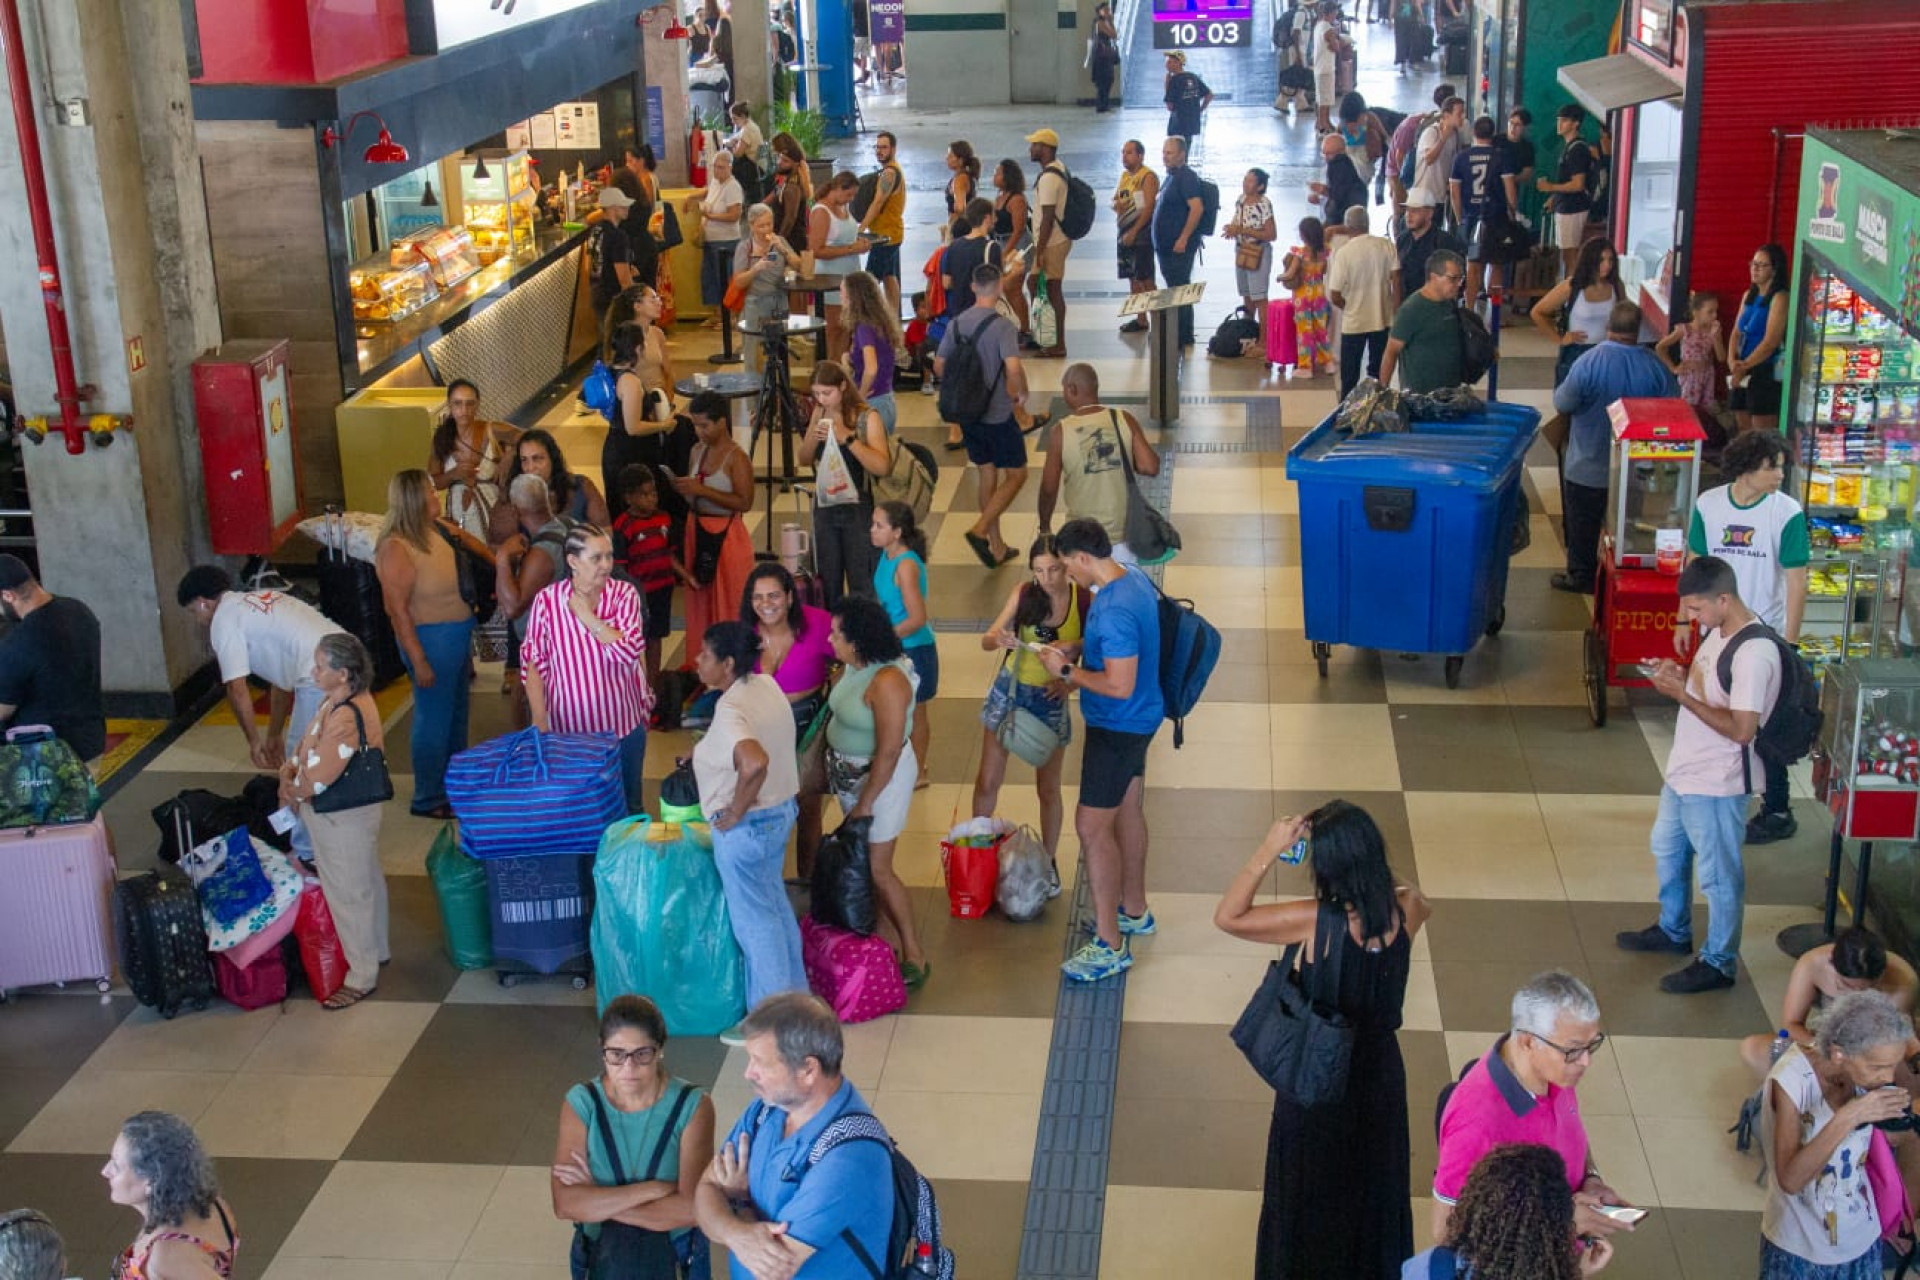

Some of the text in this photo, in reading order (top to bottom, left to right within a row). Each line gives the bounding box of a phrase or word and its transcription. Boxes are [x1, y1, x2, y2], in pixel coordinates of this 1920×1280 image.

[1170, 23, 1239, 45] 10:03
[1472, 164, 1487, 195] 2
[131, 340, 143, 369] H
